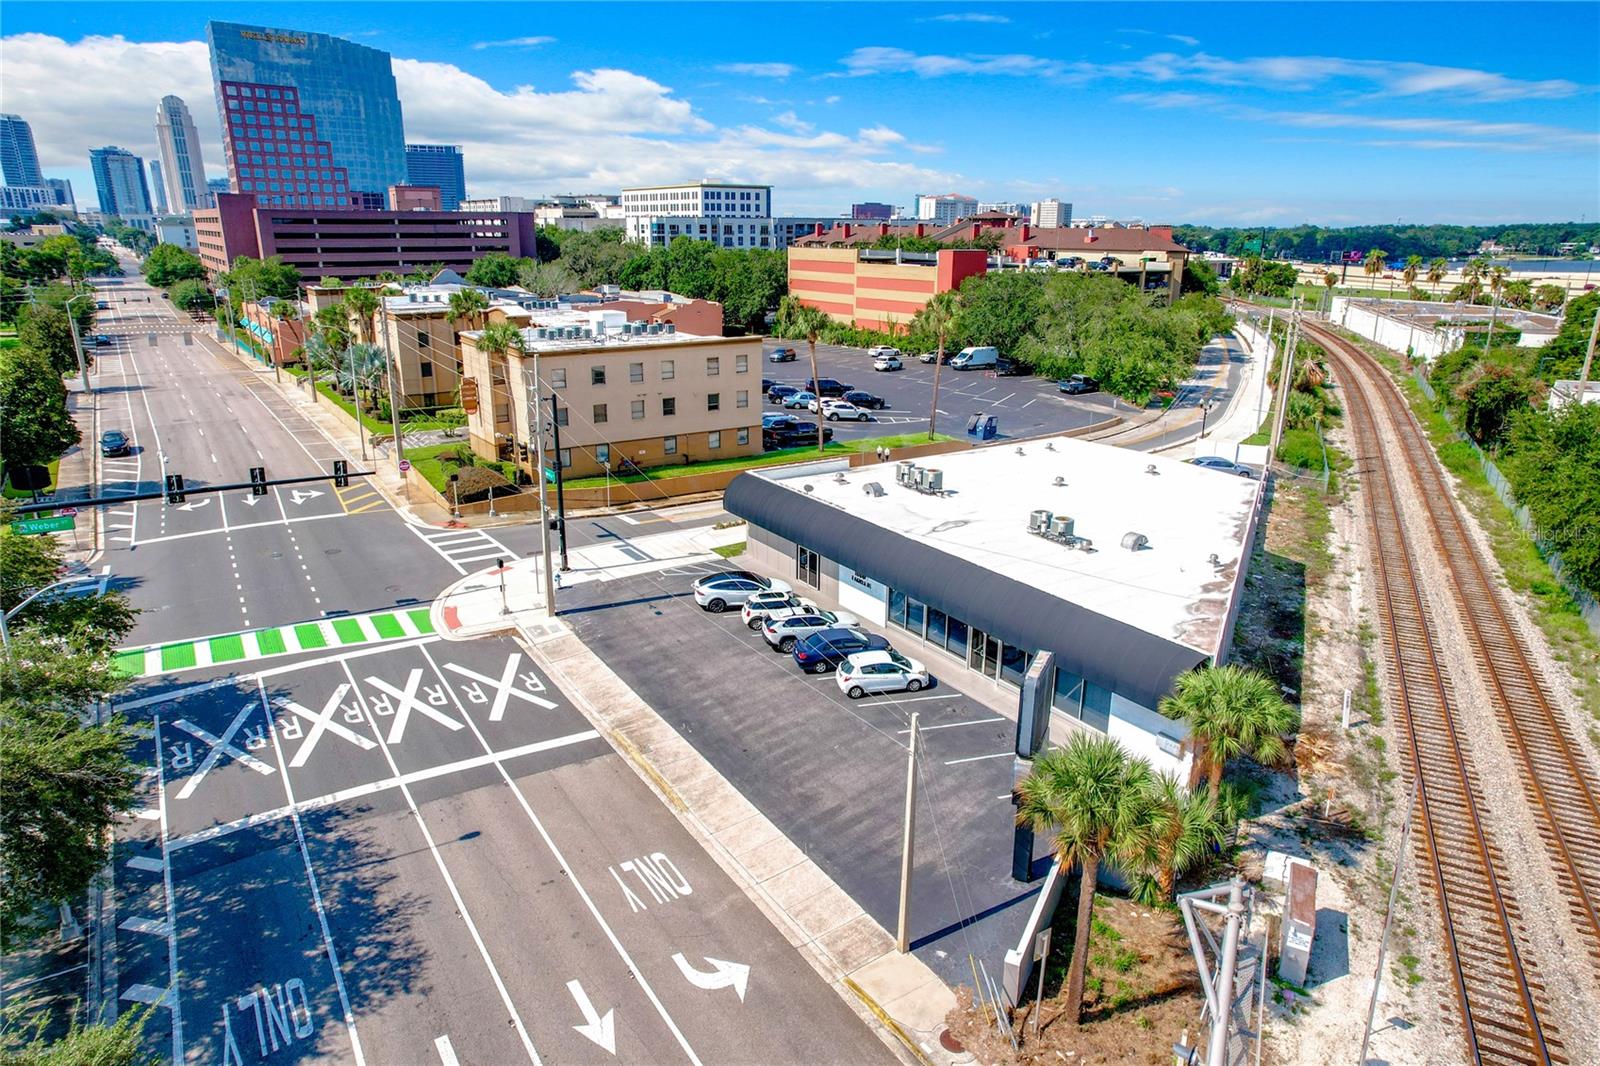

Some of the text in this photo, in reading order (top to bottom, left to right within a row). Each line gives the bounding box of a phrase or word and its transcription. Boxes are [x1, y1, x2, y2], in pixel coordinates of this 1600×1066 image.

[28, 521, 60, 532] Weber
[608, 852, 693, 913] ONLY
[222, 977, 314, 1066] ONLY
